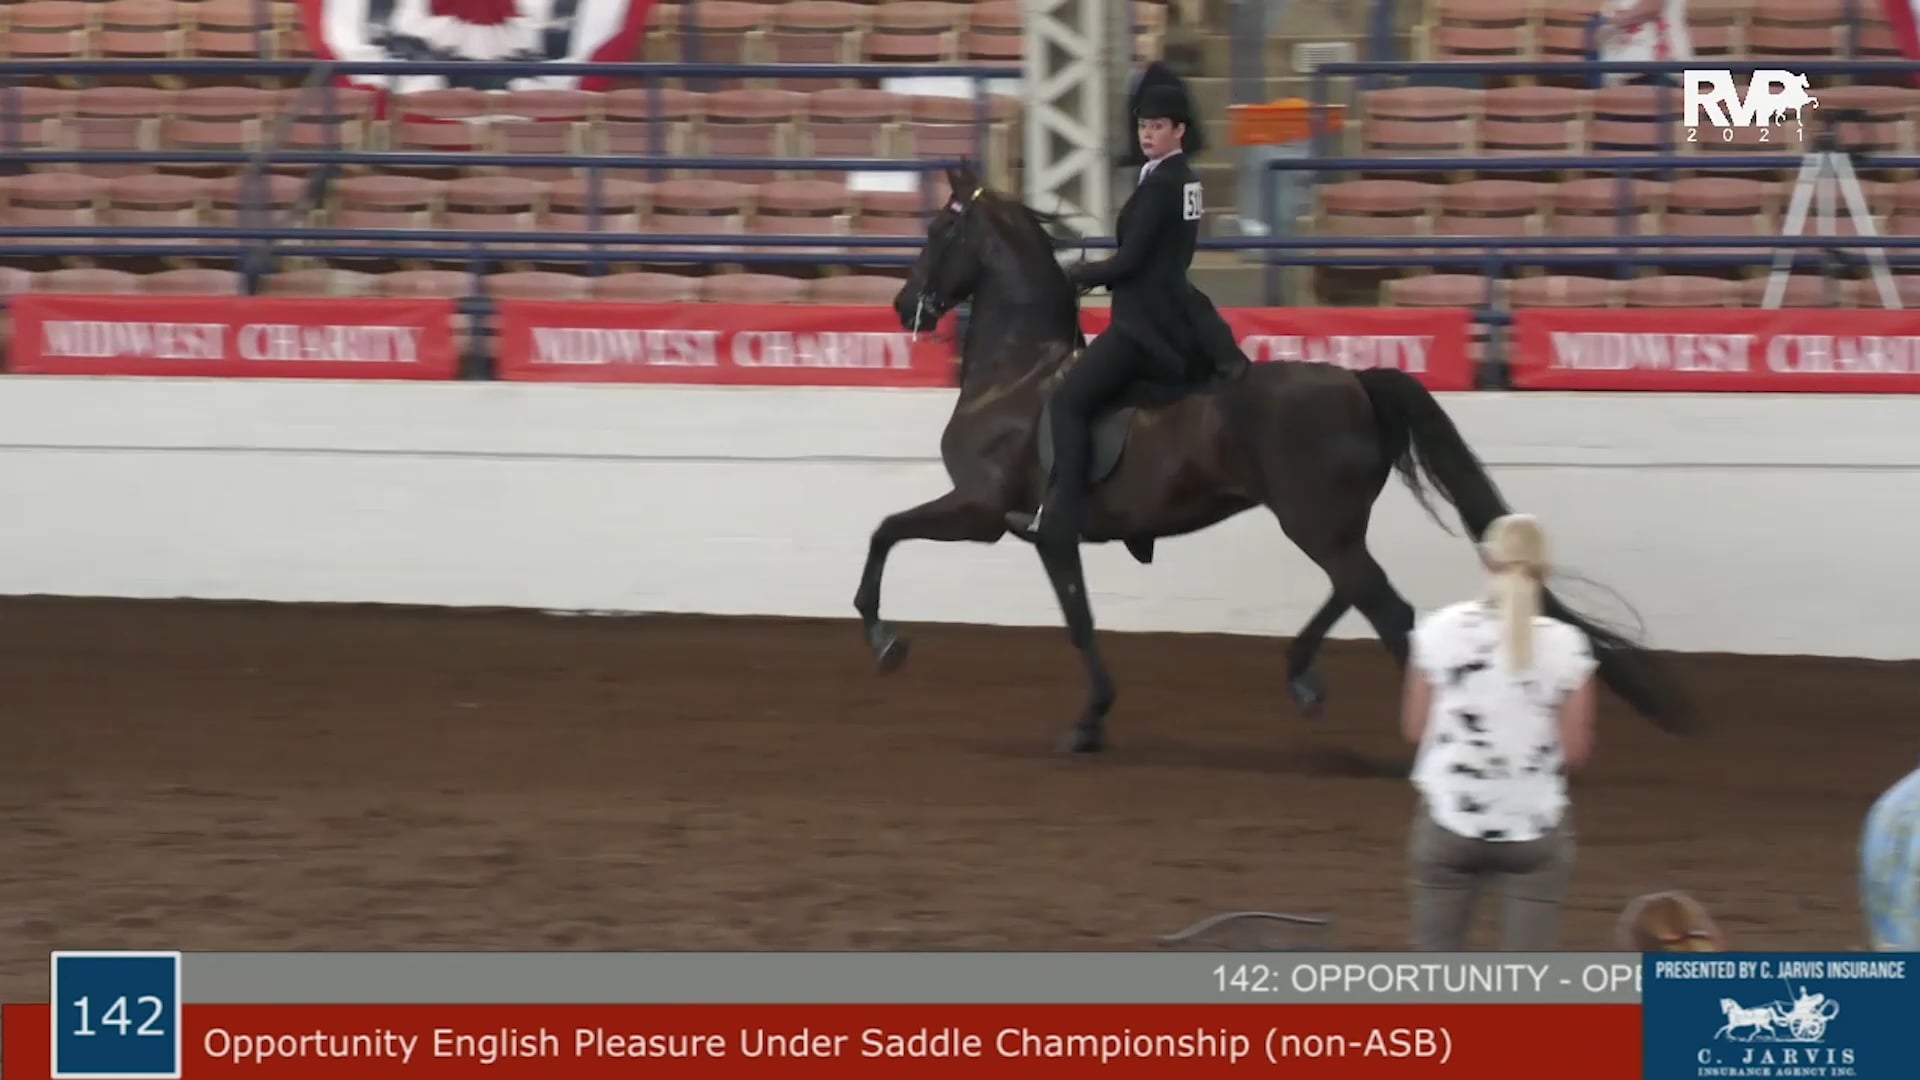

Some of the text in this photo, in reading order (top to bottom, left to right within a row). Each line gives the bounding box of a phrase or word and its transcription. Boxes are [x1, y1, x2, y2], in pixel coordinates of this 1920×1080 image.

[42, 320, 424, 362] MIDWEST CHARITY
[530, 327, 916, 369] MIDWEST CHARITY
[1549, 331, 1758, 372] MIDWEST
